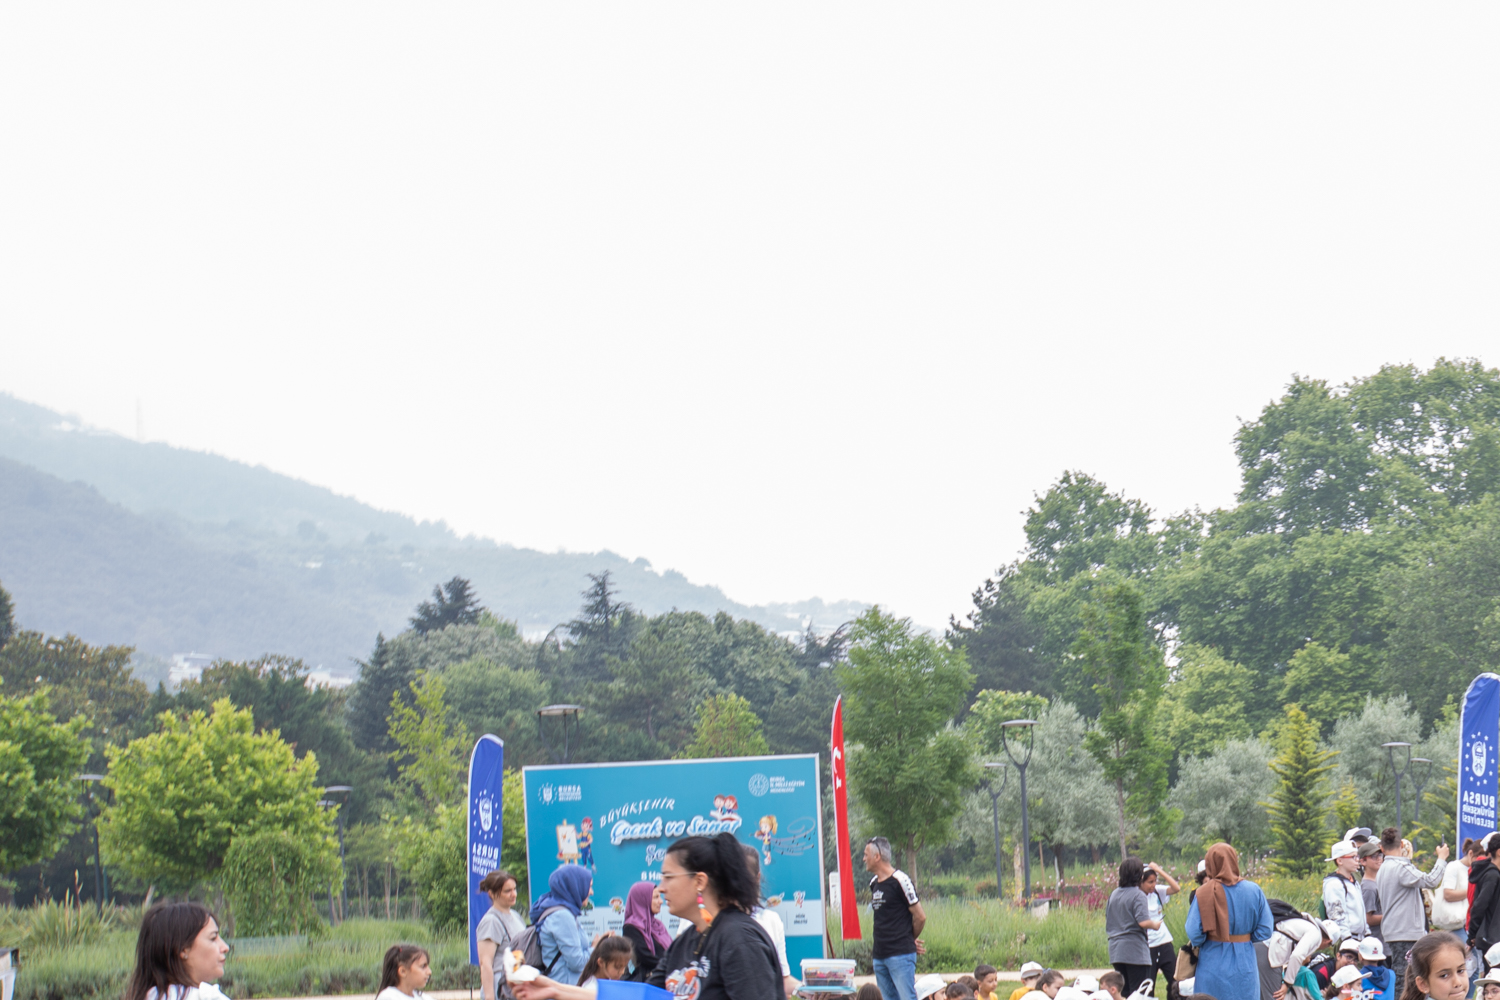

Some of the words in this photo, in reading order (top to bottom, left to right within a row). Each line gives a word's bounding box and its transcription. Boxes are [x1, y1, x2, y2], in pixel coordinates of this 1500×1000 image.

[600, 796, 676, 829] BÜYÜKŞEHİR
[610, 816, 663, 846] Çocuk
[664, 819, 687, 838] ve
[686, 815, 743, 836] Sanat
